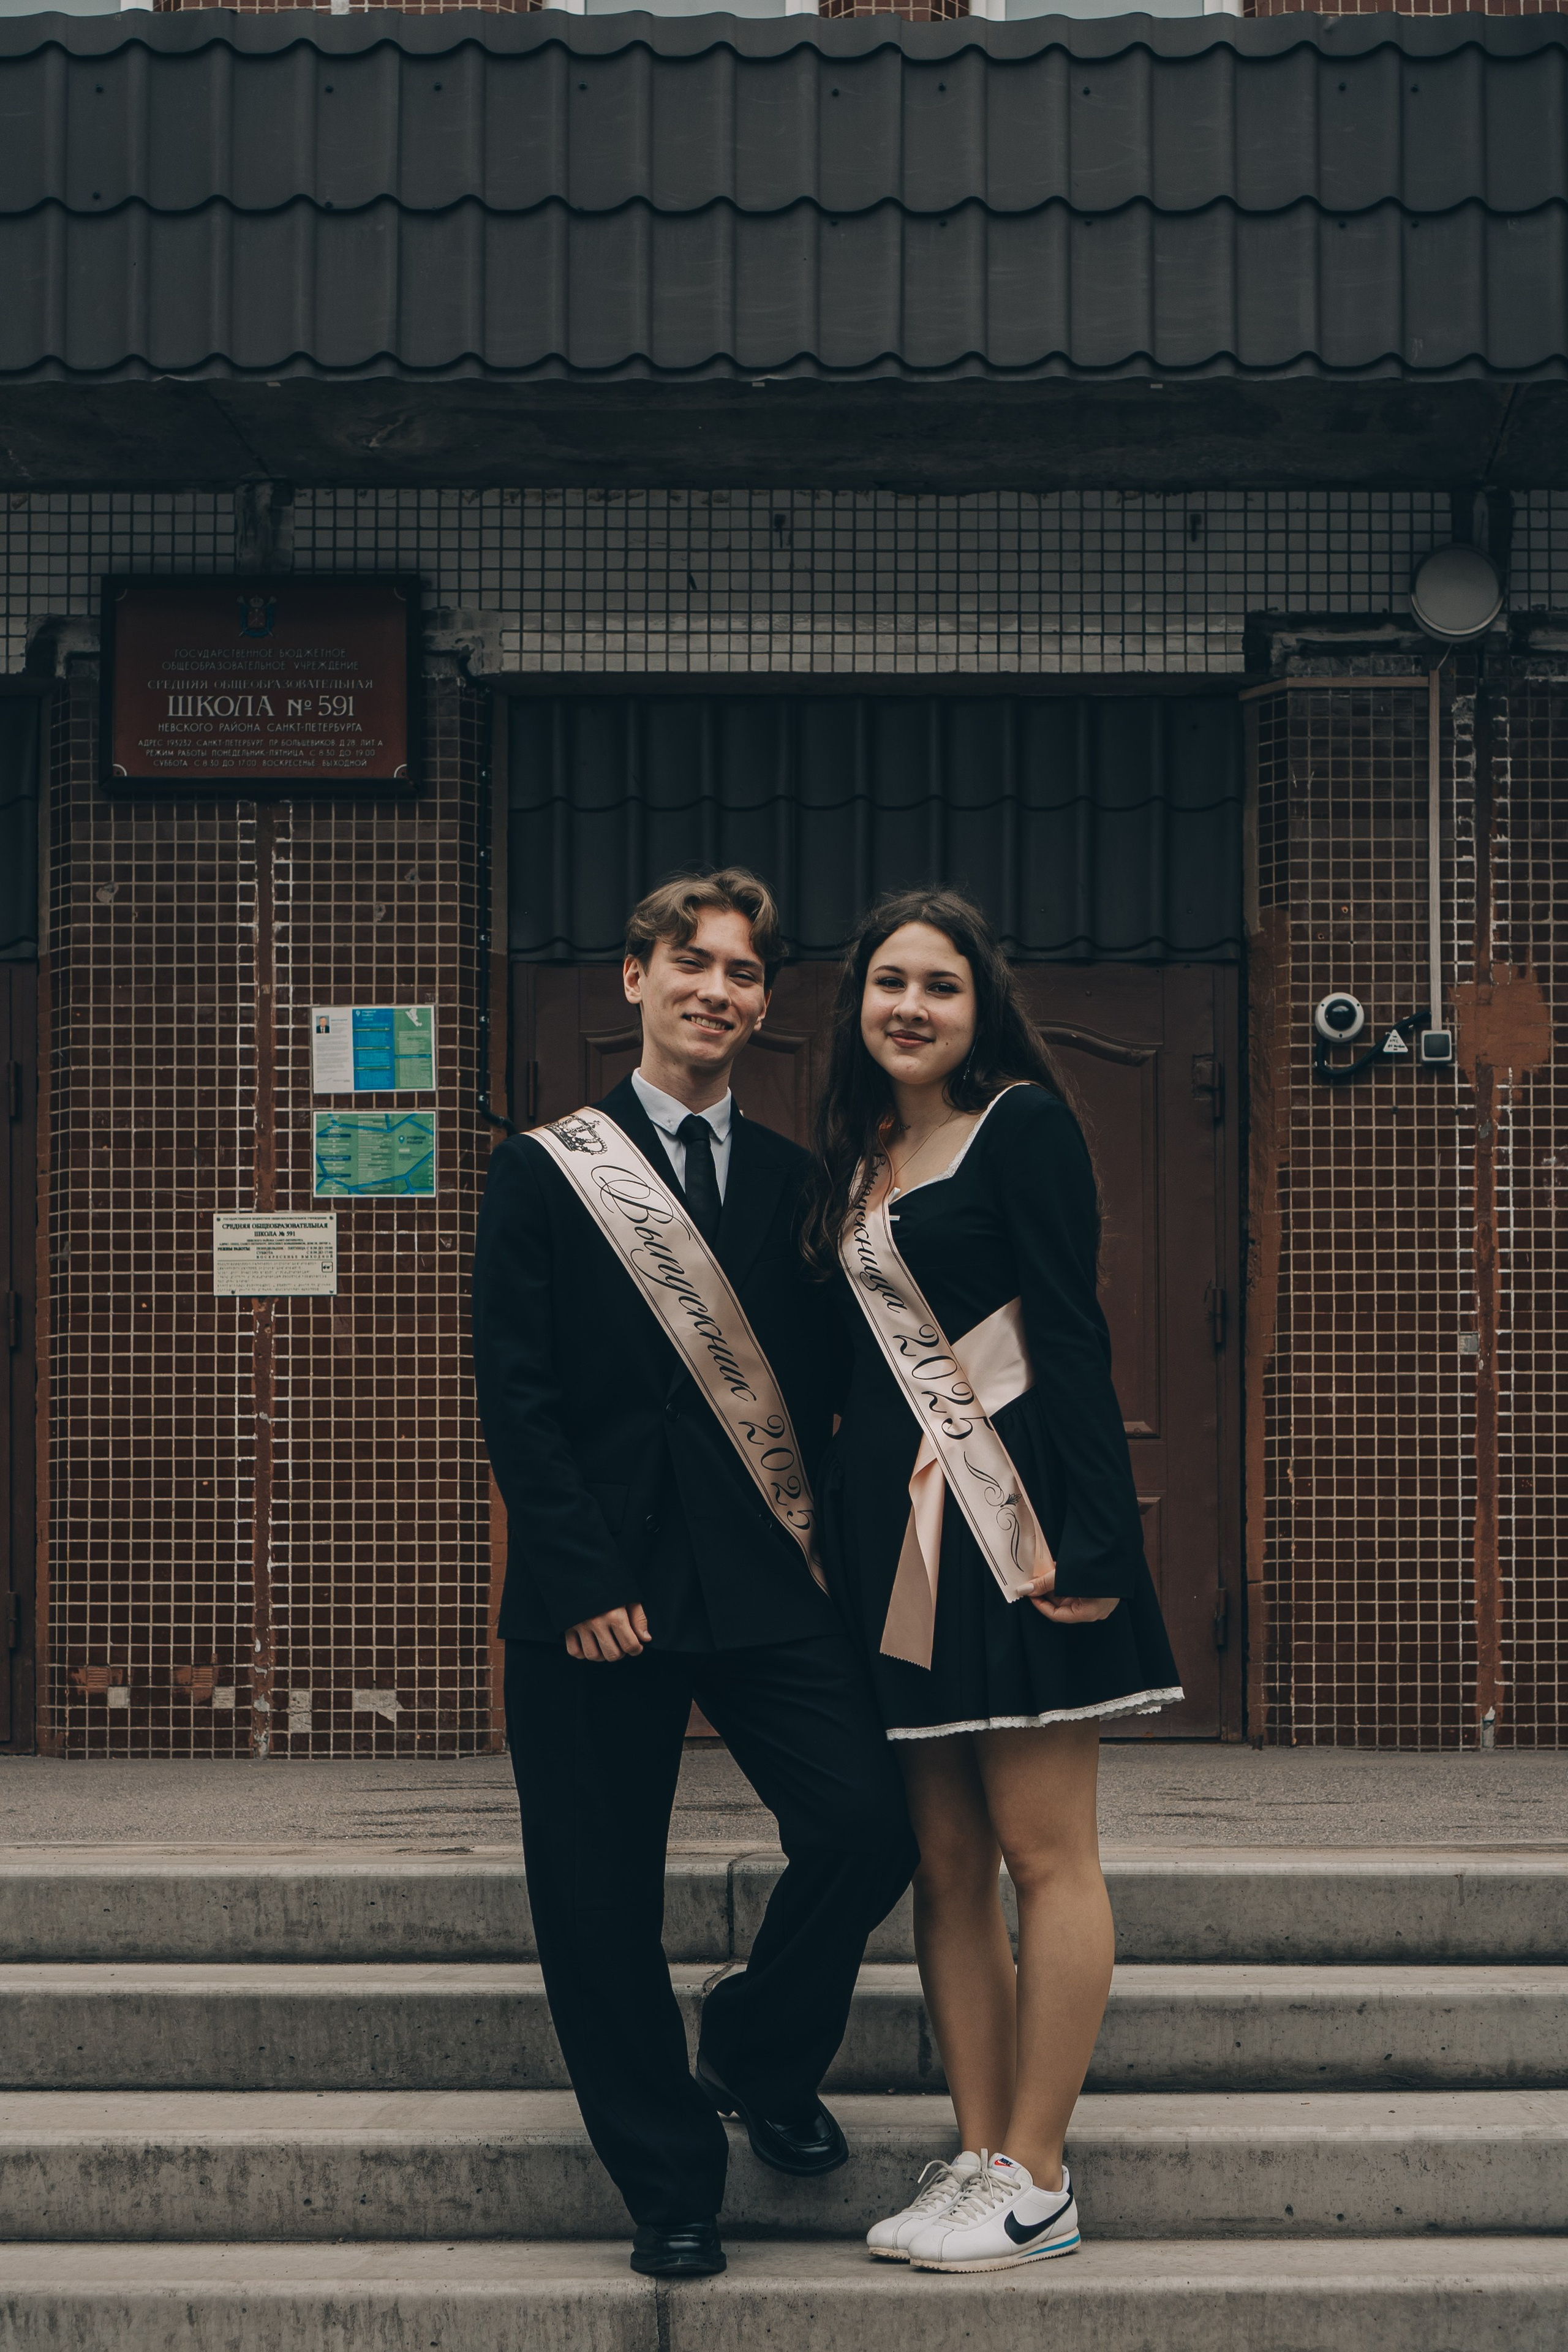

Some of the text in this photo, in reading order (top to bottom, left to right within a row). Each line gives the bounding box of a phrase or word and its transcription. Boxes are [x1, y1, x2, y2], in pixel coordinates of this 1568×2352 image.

[175, 648, 347, 658] ГОСУДАРСТВЕННОЕ БЮДЖЕТНОЕ
[162, 660, 359, 671] ОБЩЕОБРАЗОВАТЕЛЬНОЕ УЧРЕЖДЕНИЕ
[148, 679, 373, 690] СРЕДНЯЯ ОБЩЕОБРАЗОВАТЕЛЬНАЯ
[167, 695, 356, 717] ШКОЛА № 591
[158, 721, 363, 732] НЕВСКОГО РАЙОНА САНКТ-ПЕТЕРБУРГА
[322, 758, 368, 767] ВЫХОДНОЙ
[590, 1165, 816, 1530] Выпускник 2025
[892, 1323, 994, 1440] 2025
[999, 2157, 1014, 2166] NIKE
